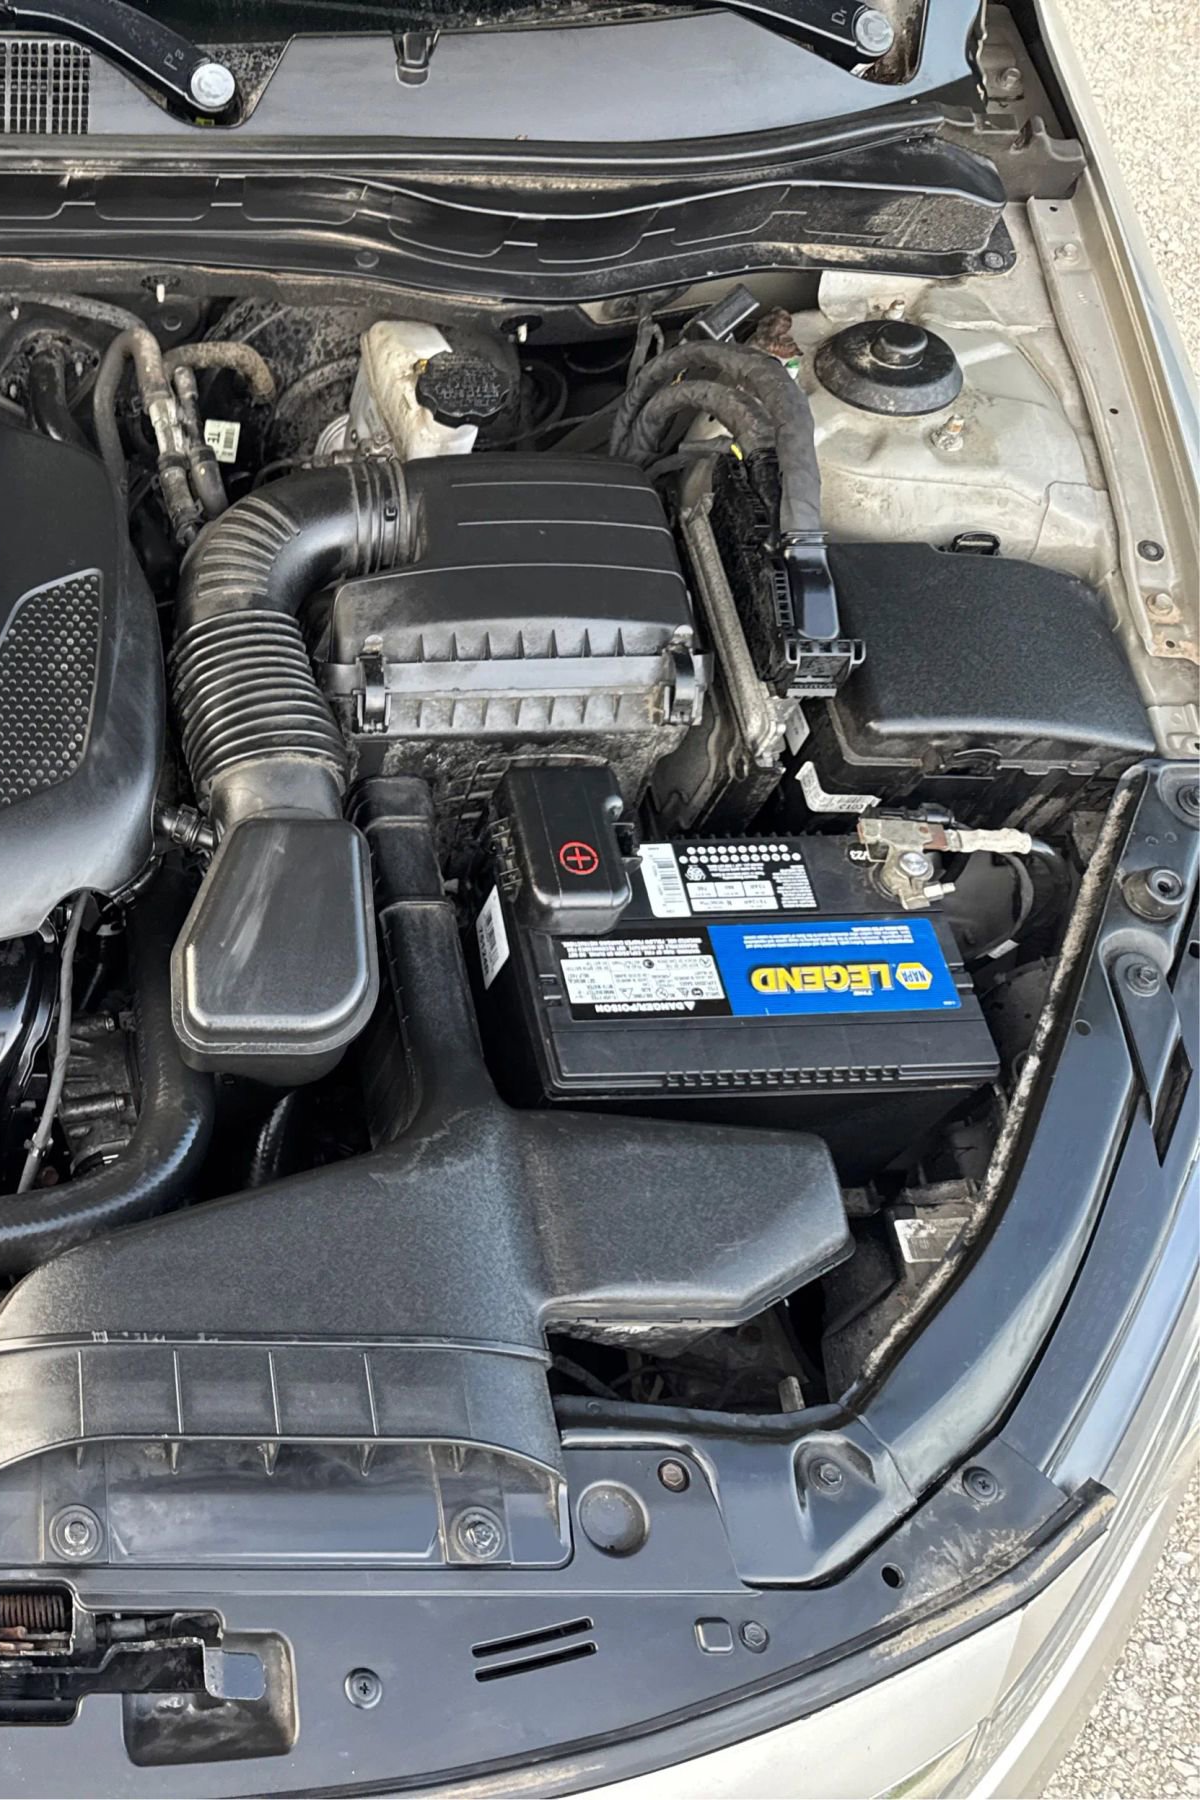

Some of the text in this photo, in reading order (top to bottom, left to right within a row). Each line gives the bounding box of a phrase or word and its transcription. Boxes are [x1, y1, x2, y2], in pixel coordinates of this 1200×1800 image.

[749, 963, 894, 992] LEGEND
[901, 971, 928, 984] NAPA
[594, 1001, 686, 1013] DANGER/POISON
